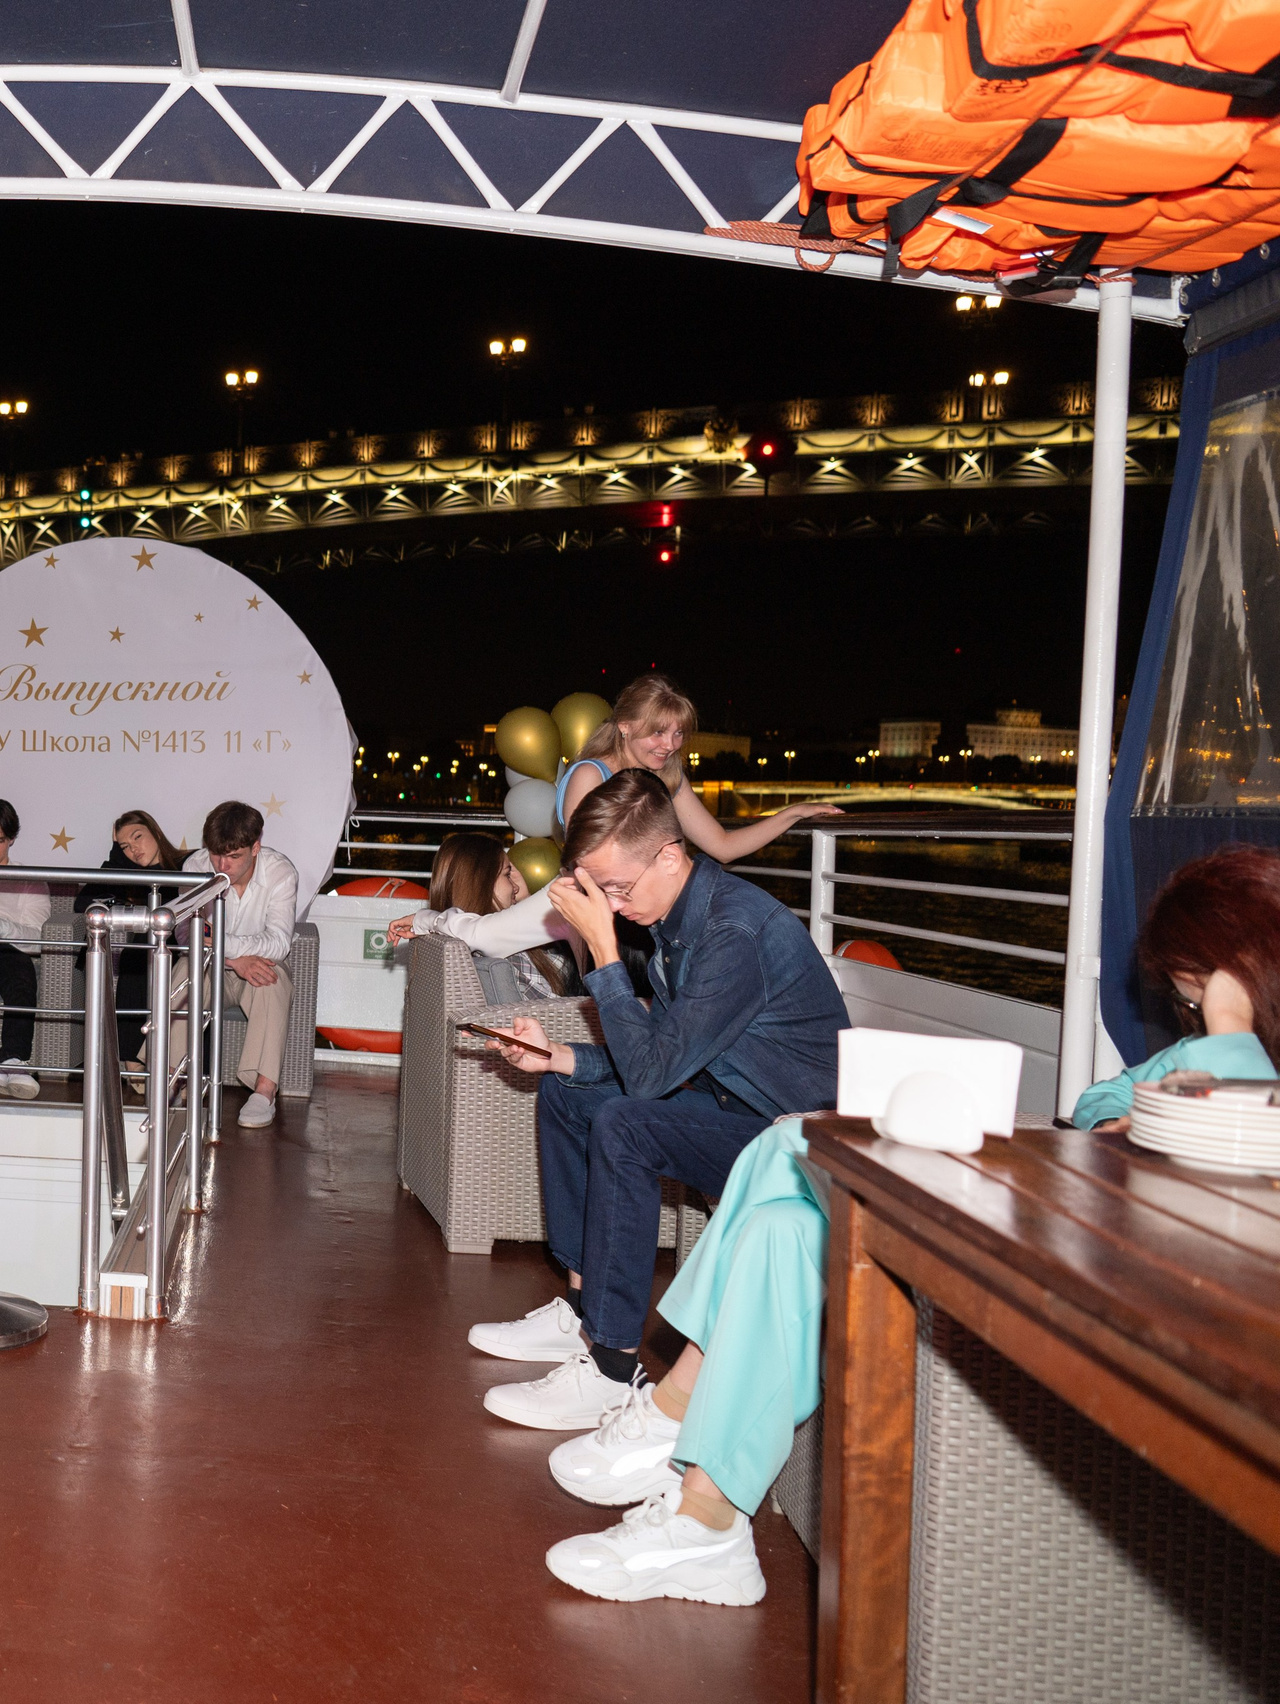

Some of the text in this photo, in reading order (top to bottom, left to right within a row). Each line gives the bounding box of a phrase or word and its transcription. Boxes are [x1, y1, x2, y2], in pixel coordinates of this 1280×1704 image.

[20, 729, 111, 753] Школа
[121, 729, 207, 753] №1413
[223, 730, 241, 753] 11
